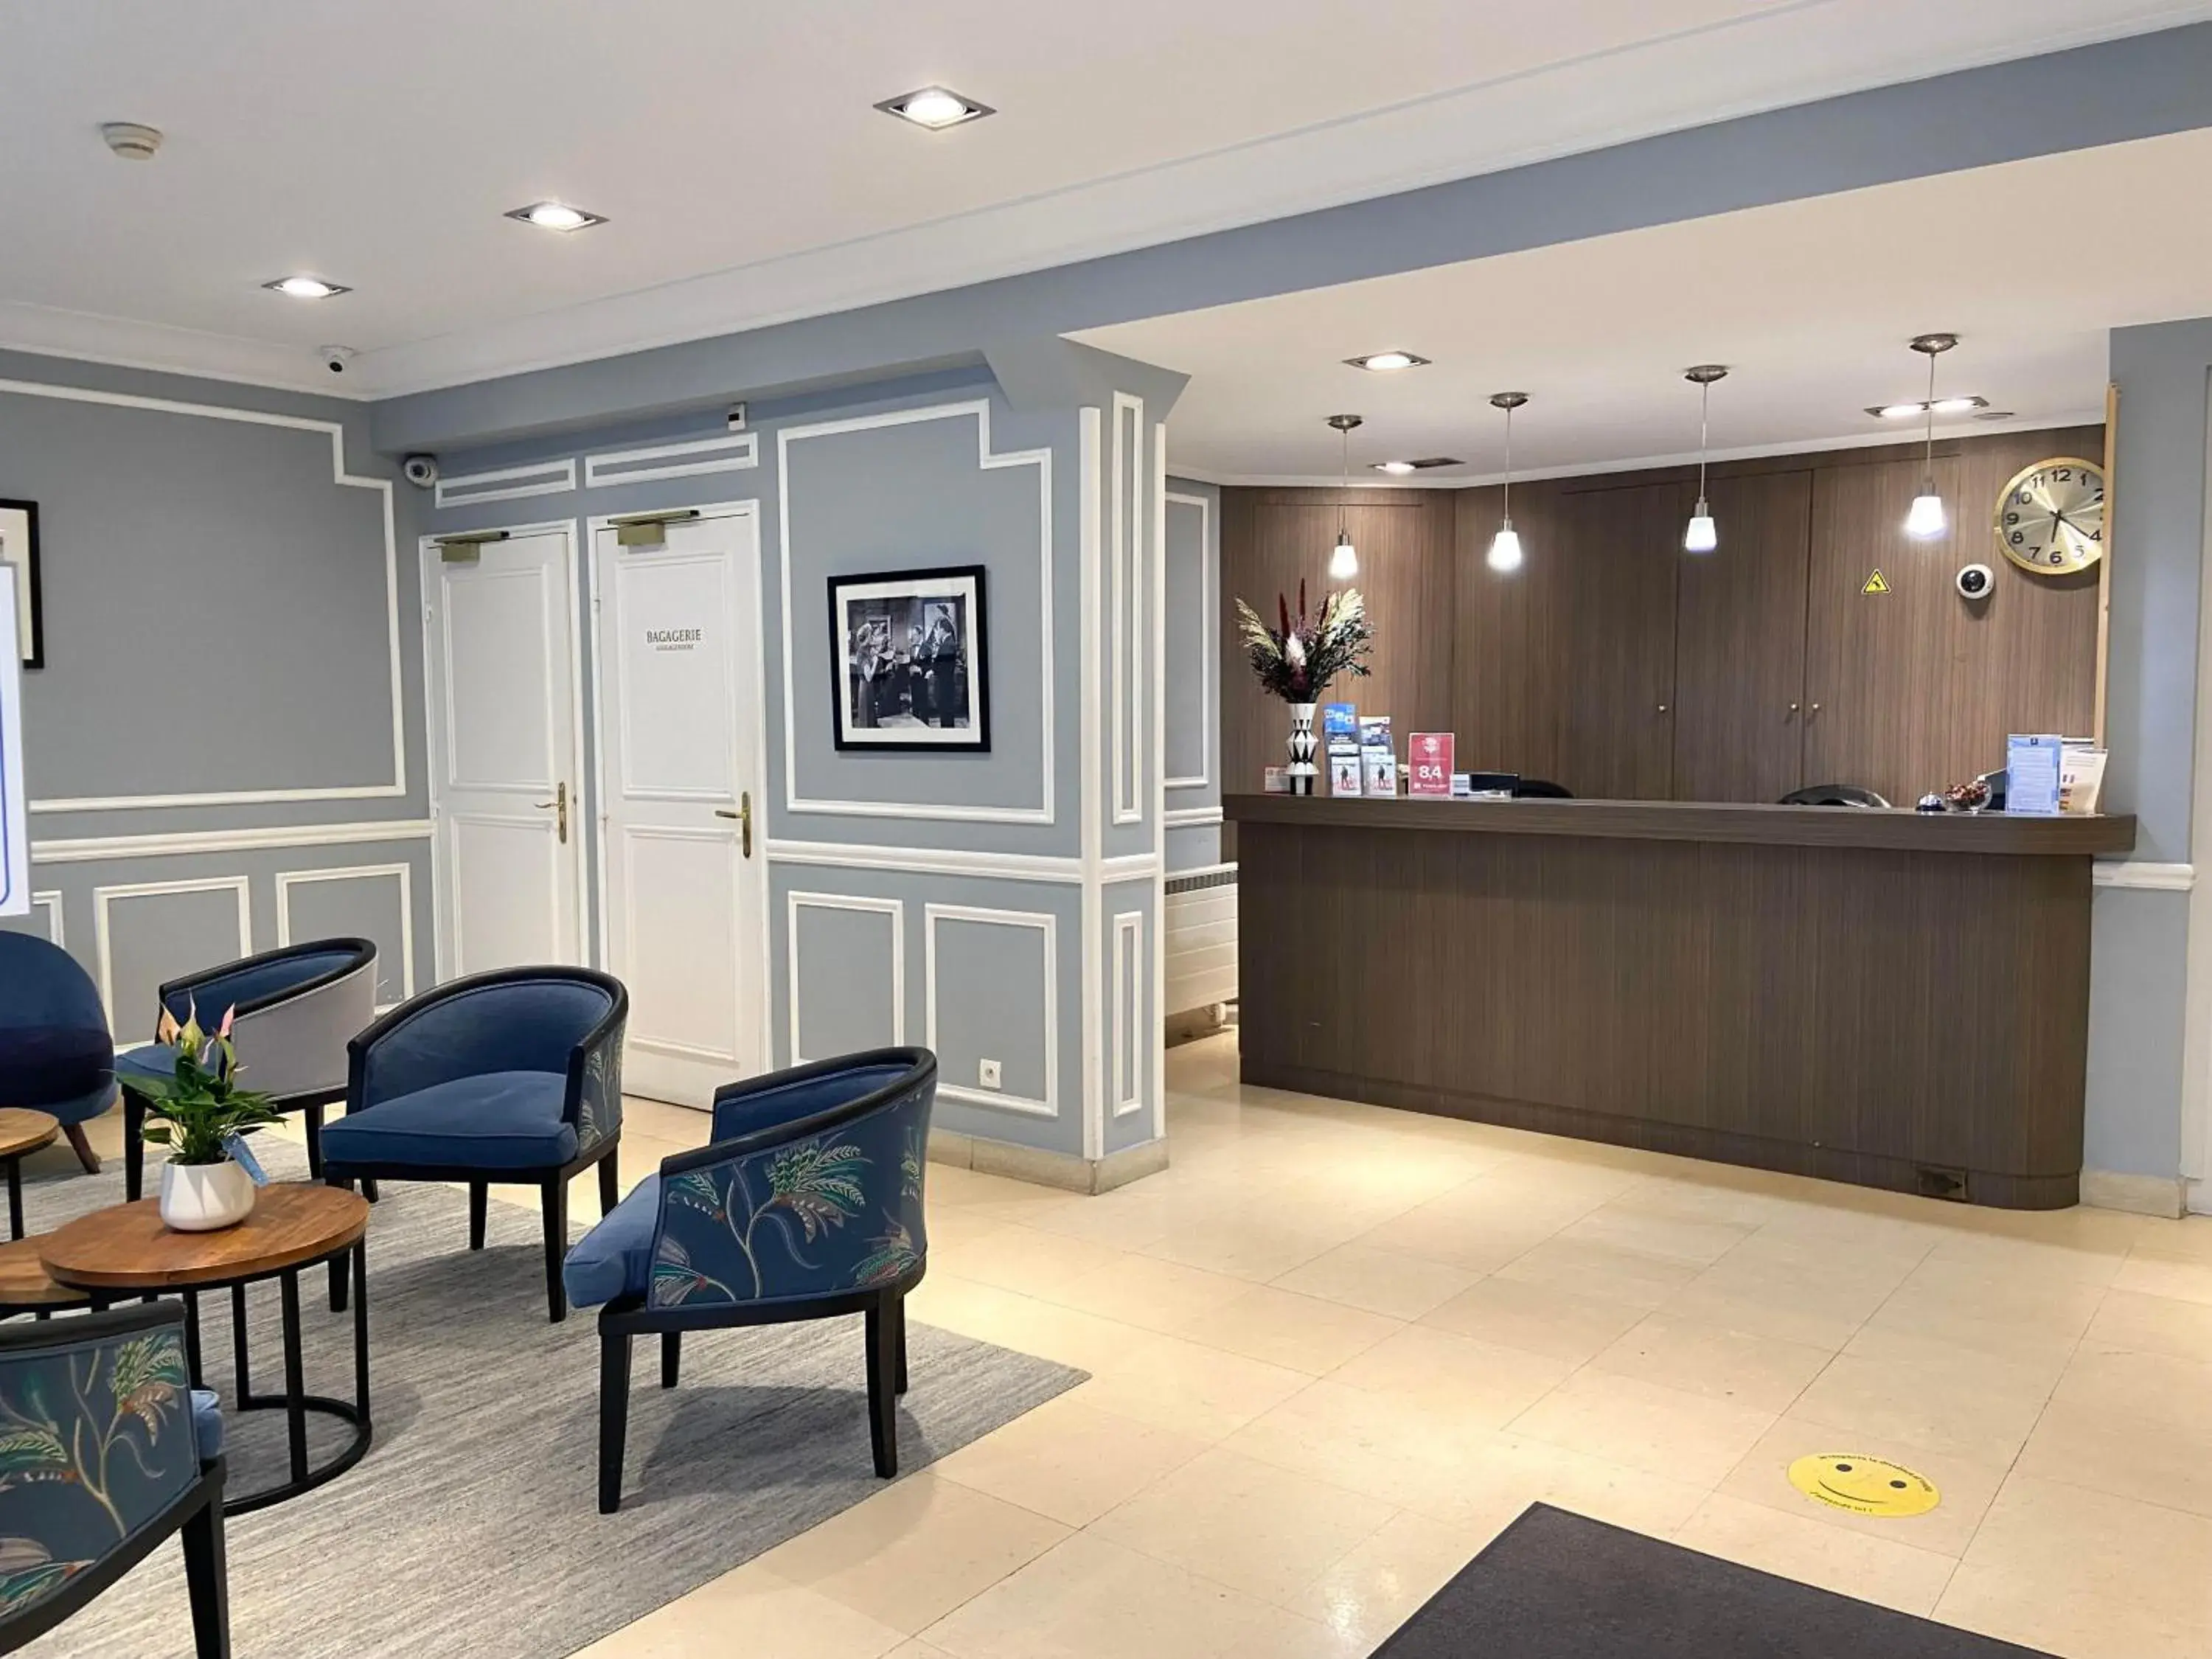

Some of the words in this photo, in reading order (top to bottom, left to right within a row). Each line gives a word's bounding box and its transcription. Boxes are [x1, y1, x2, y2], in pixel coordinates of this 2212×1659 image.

[2032, 476, 2045, 488] 11
[2051, 469, 2071, 482] 12
[2080, 473, 2087, 486] 1
[2014, 492, 2033, 504] 10
[2006, 512, 2019, 525] 9
[2011, 531, 2024, 544] 8
[2089, 529, 2102, 541] 4
[2028, 546, 2041, 559] 7
[2074, 545, 2085, 557] 5
[2050, 552, 2062, 564] 6
[647, 629, 701, 644] BAGAGERIE
